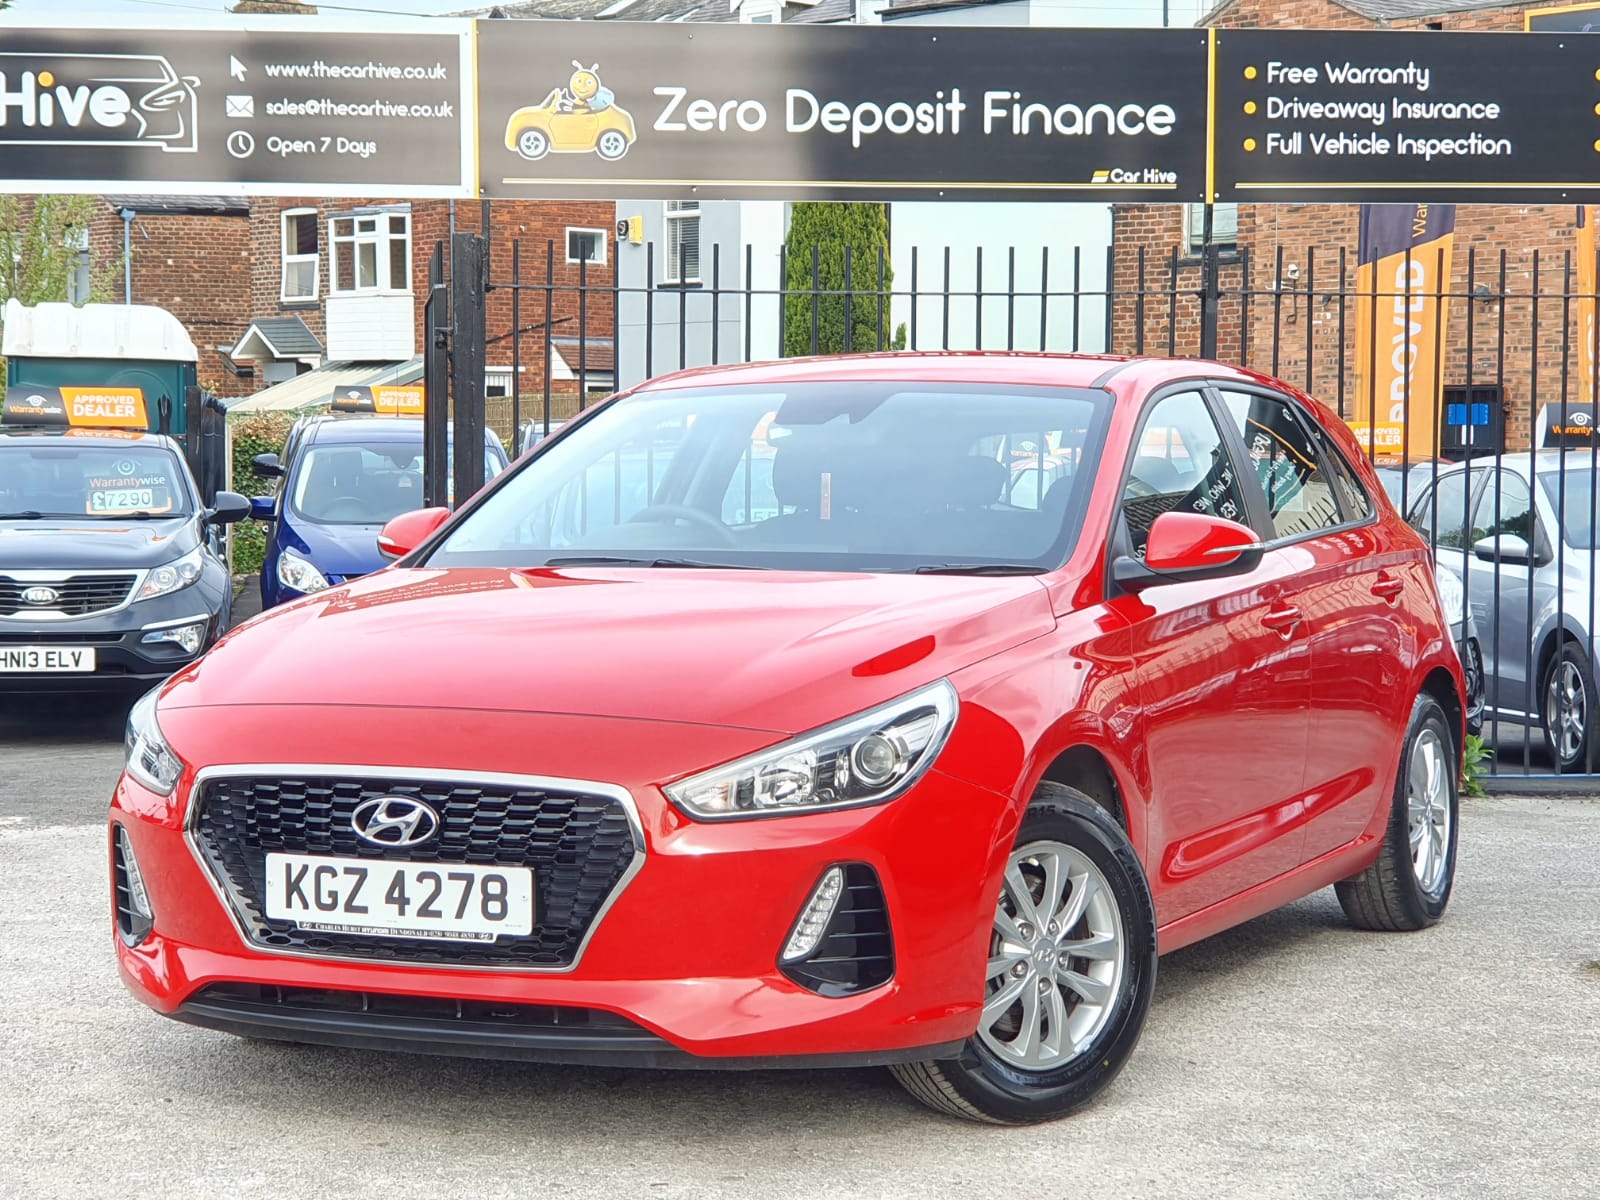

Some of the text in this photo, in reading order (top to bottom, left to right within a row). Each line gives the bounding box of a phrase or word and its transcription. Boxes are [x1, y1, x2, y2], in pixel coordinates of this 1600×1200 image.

[265, 61, 446, 80] www.thecarhive.co.uk
[1267, 61, 1430, 91] Free Warranty
[0, 71, 132, 128] Hive
[266, 99, 453, 118] sales@thecarhive.co.uk
[653, 87, 1176, 148] Zero Deposit Finance
[1267, 97, 1500, 126] Driveaway Insurance
[267, 137, 377, 158] Open 7 Days
[1267, 132, 1512, 161] Full Vehicle Inspection
[1110, 168, 1177, 184] Car Hive
[74, 395, 135, 404] APPROVED
[380, 398, 420, 406] DEALER
[73, 404, 136, 417] DEALER
[90, 475, 166, 488] Warrantywise
[0, 651, 82, 668] HN13 ELV
[285, 862, 509, 921] KGZ 4278
